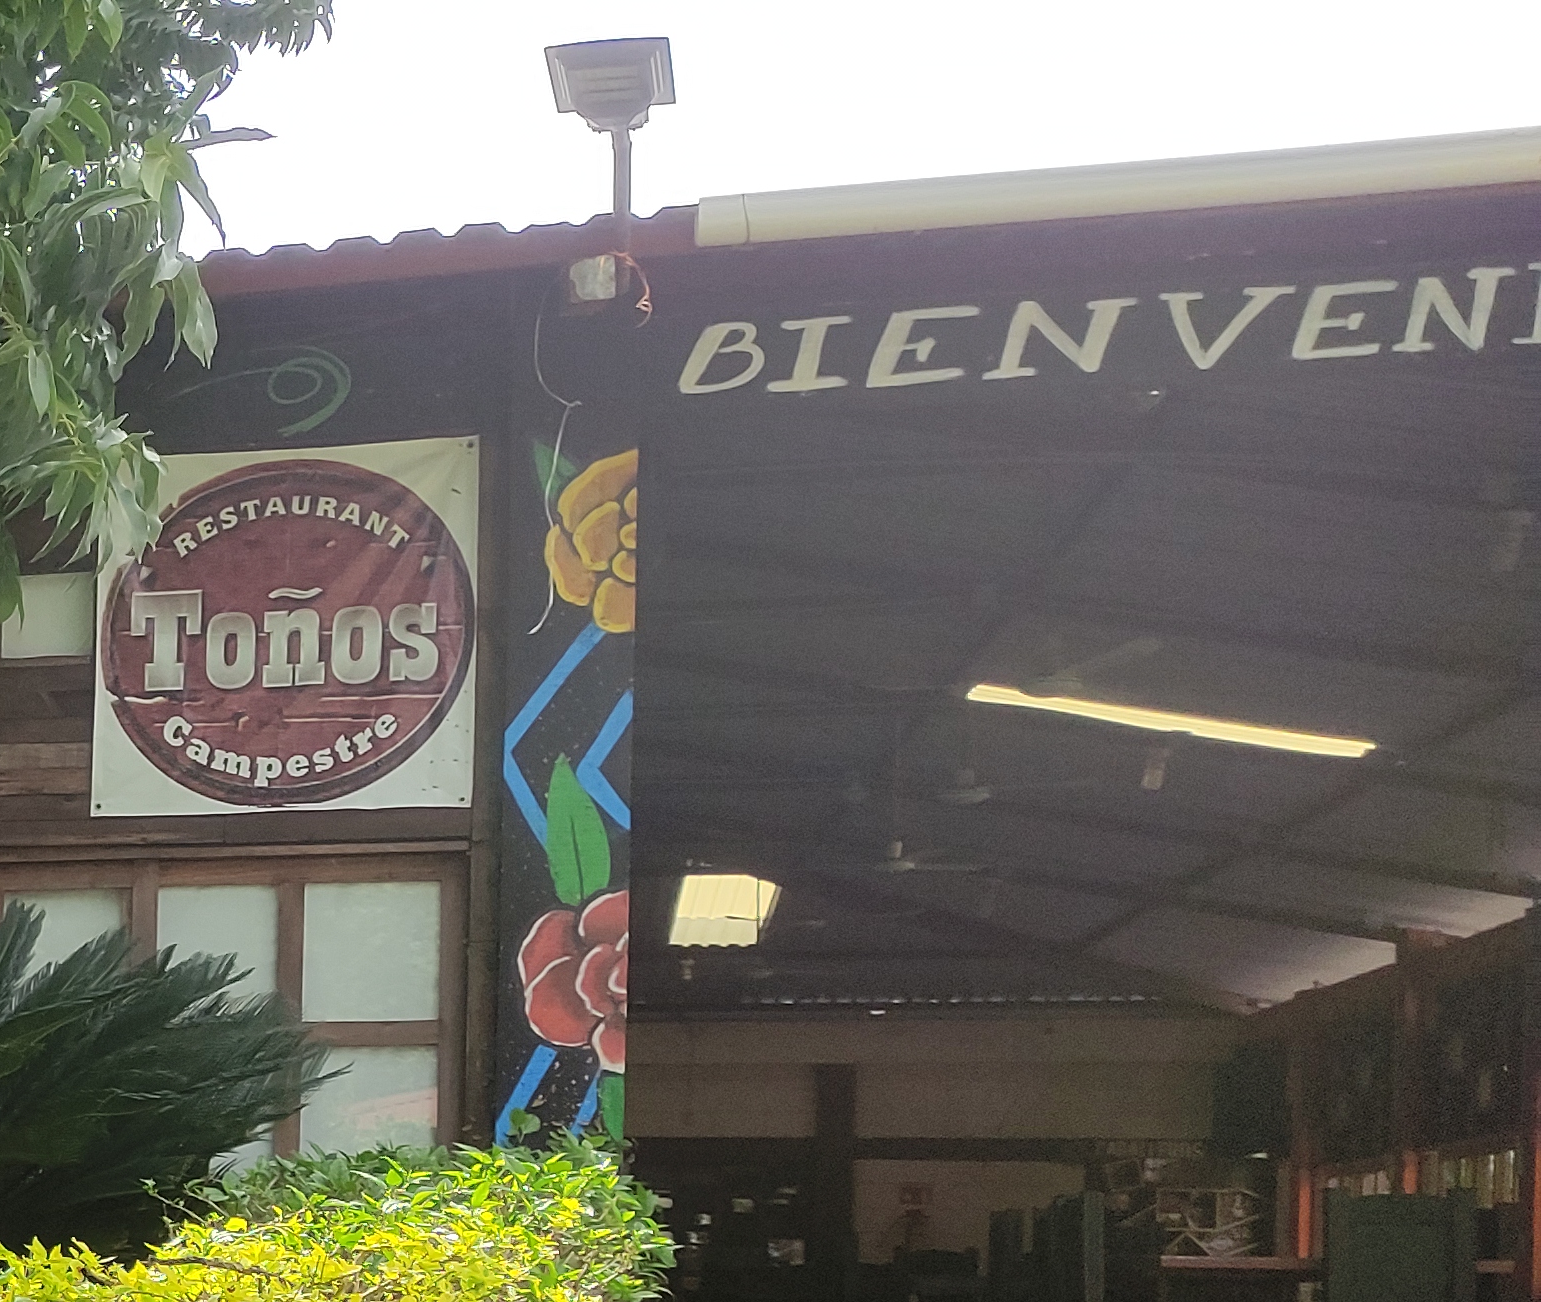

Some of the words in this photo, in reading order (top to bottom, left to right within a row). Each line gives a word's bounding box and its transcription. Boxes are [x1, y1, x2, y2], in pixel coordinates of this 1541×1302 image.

[172, 495, 410, 558] RESTAURANT
[130, 587, 439, 692] Toños
[163, 712, 398, 787] Campestre
